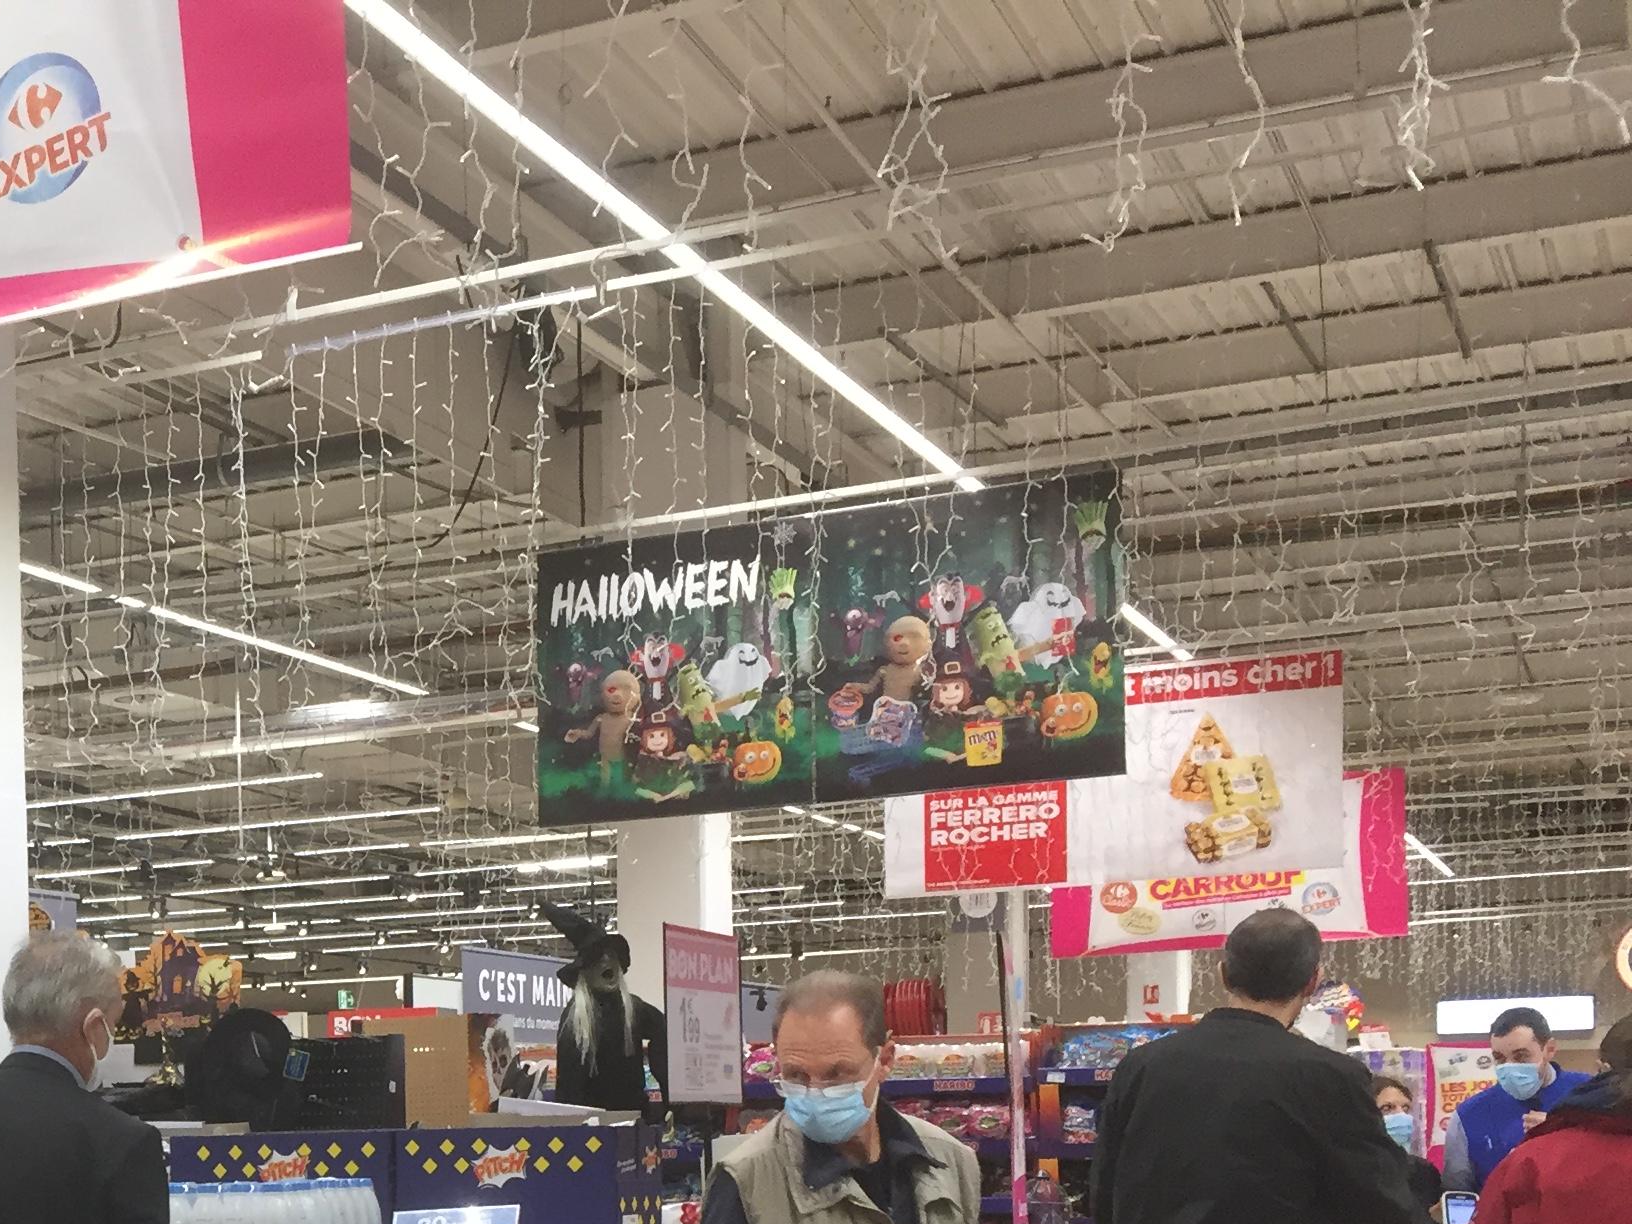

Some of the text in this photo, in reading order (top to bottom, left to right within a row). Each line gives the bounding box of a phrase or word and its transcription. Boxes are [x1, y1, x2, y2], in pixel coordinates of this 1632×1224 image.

[1143, 666, 1239, 694] moins
[1247, 659, 1318, 685] cher
[929, 790, 1059, 811] SUR LA GAMME
[930, 802, 1061, 829] FERRERO
[930, 822, 1049, 847] ROCHER
[700, 952, 734, 984] PLAN
[478, 968, 527, 1004] C'EST
[473, 1150, 529, 1184] PITCH
